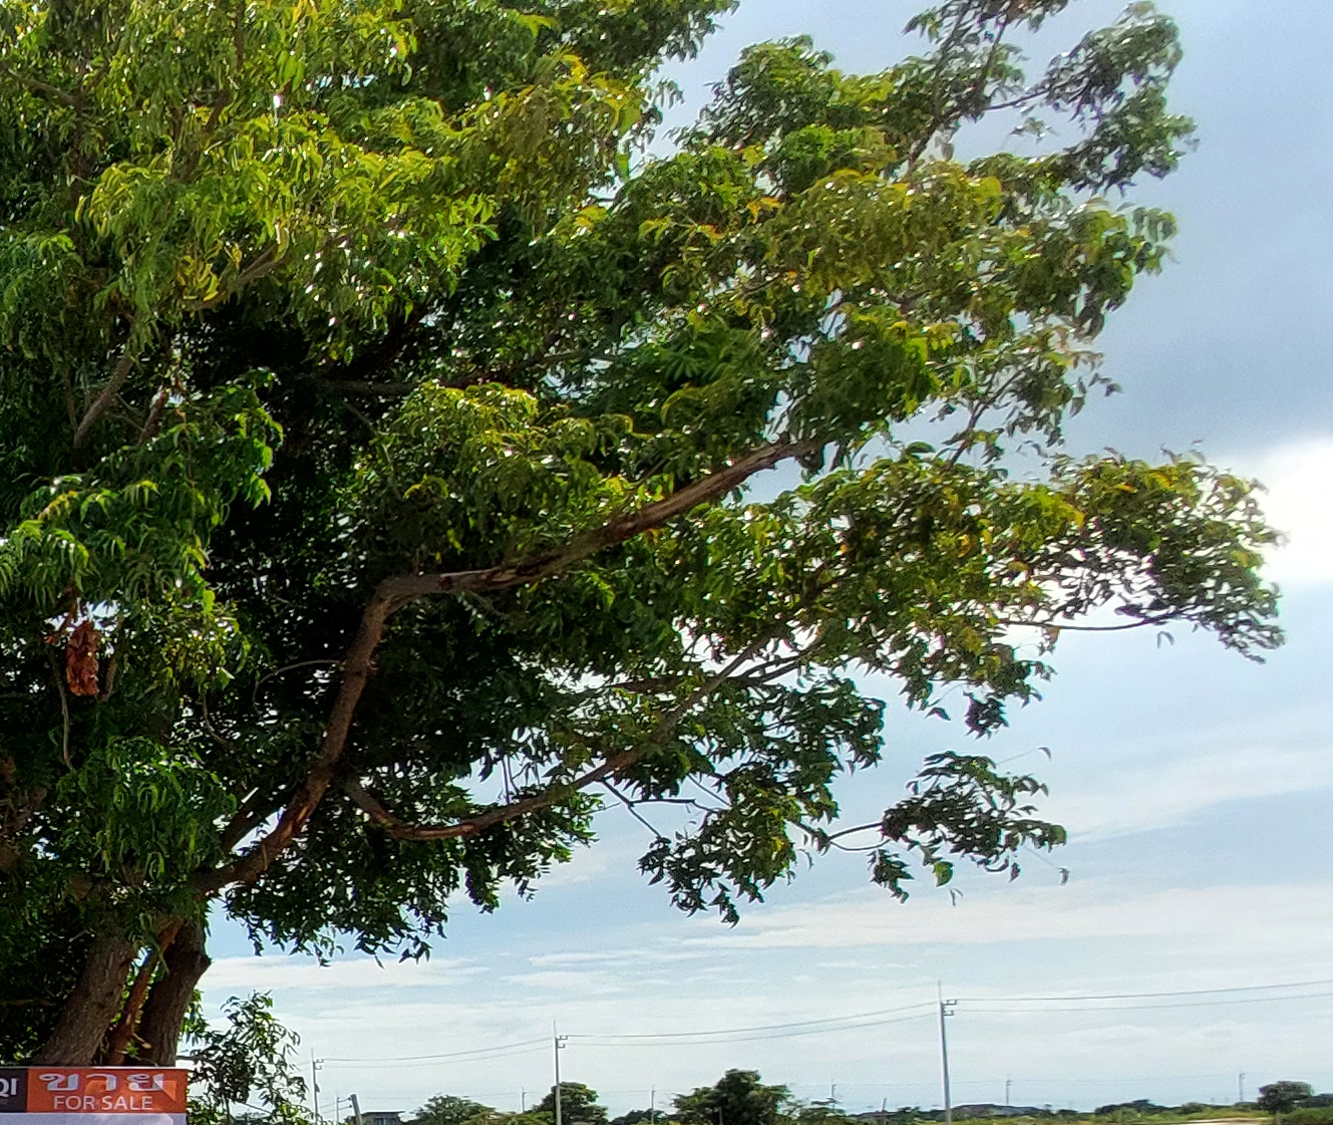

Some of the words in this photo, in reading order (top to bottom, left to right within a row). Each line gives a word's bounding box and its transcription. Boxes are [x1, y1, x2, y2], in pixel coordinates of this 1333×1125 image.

[39, 1073, 165, 1092] ขาย
[53, 1096, 95, 1110] FOR
[101, 1096, 153, 1111] SALE
